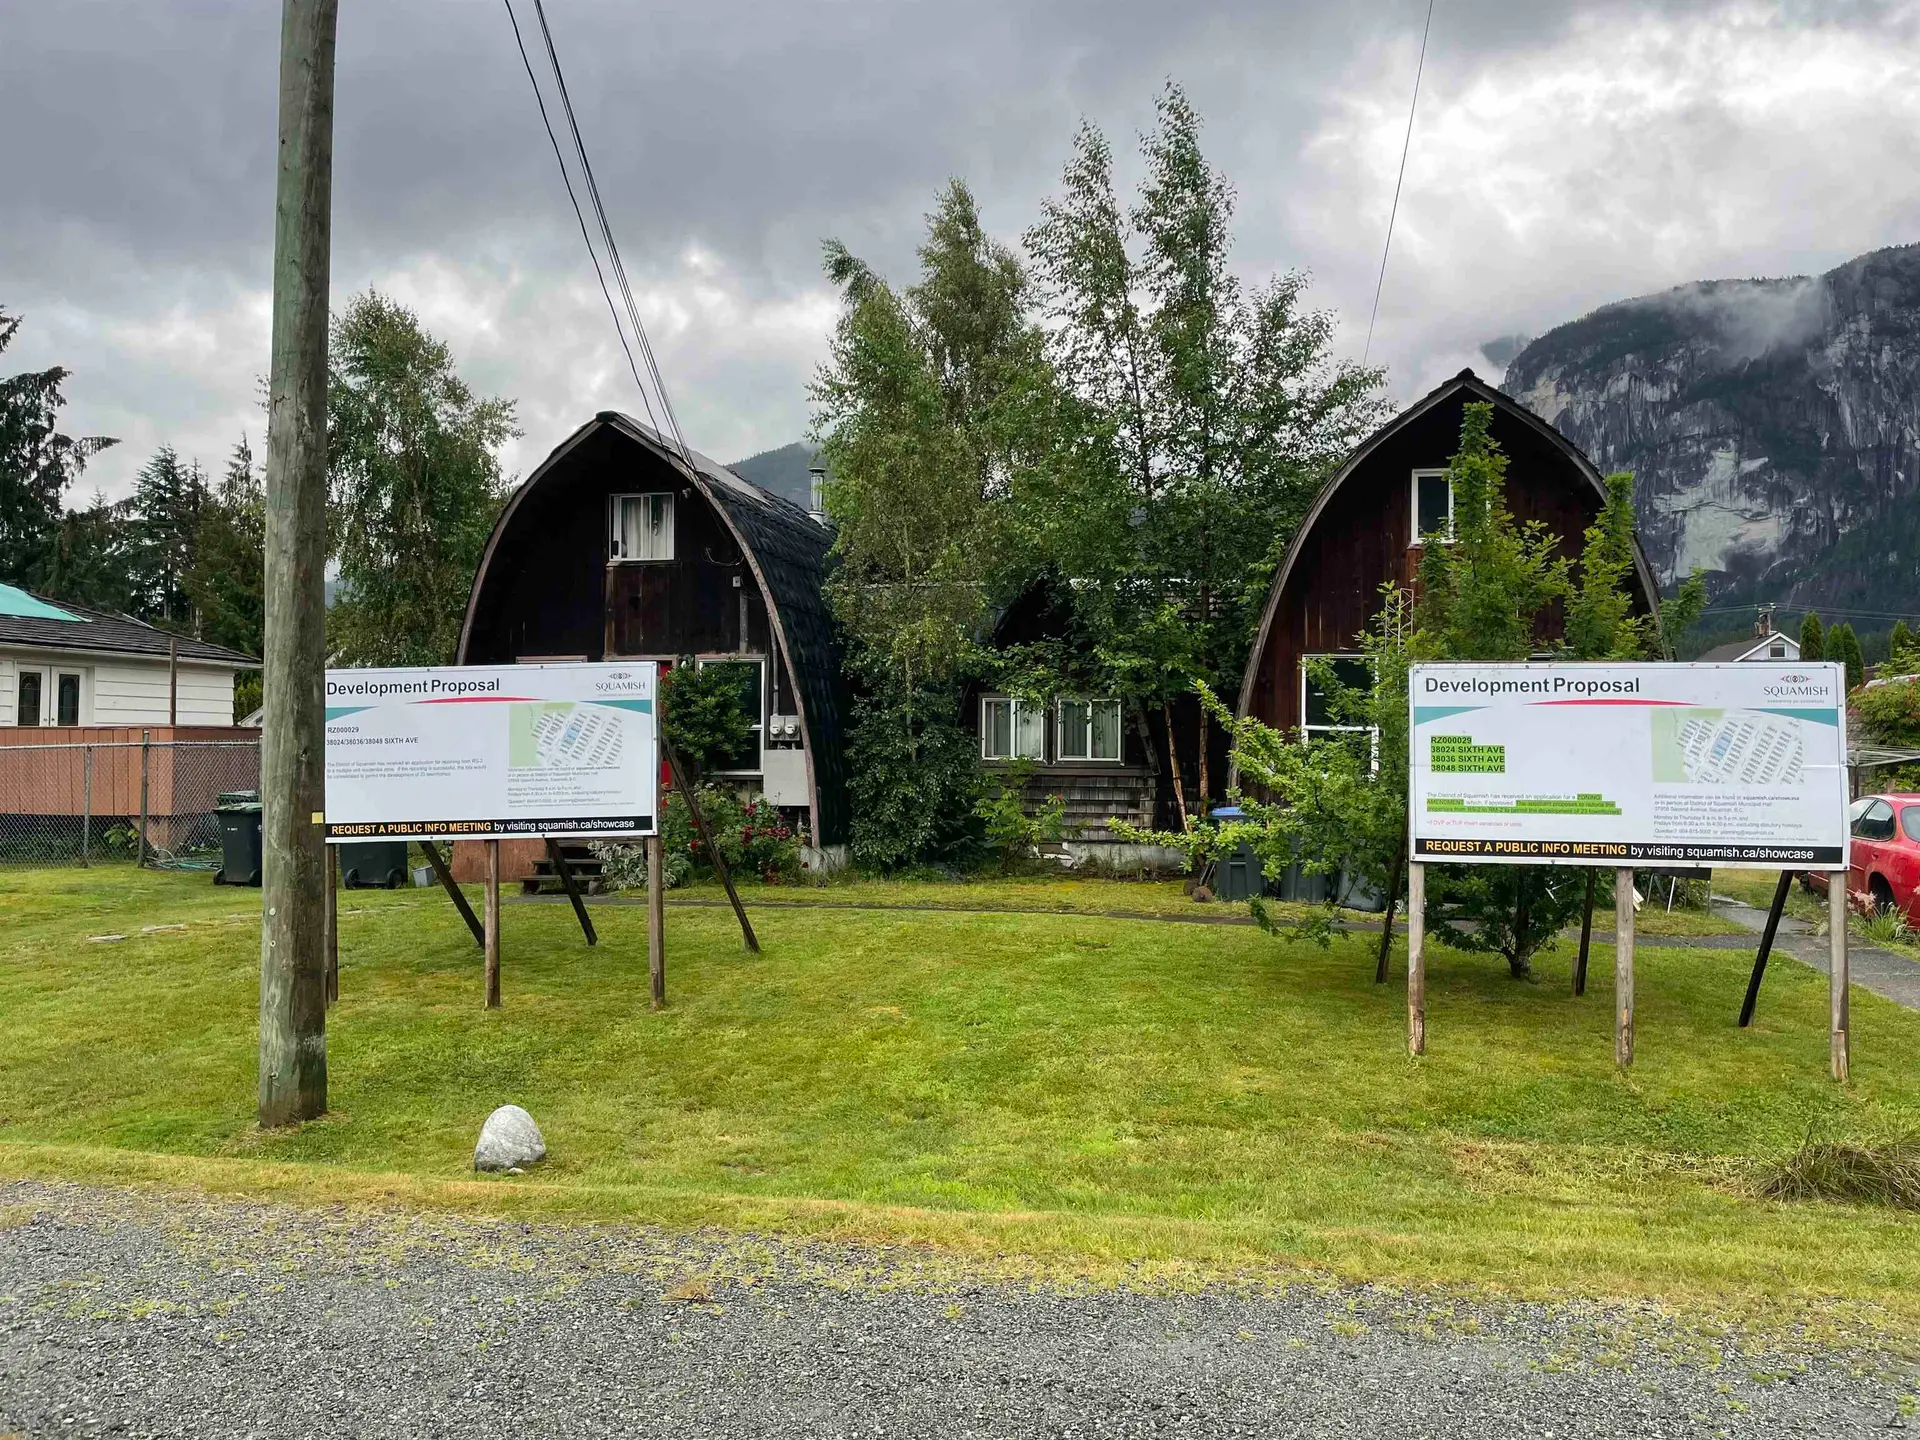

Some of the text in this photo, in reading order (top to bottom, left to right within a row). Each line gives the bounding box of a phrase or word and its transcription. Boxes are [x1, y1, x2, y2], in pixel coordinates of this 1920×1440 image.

[327, 678, 500, 696] Development Proposal
[595, 682, 646, 691] SQUAMISH
[1425, 678, 1640, 696] Development Proposal
[1763, 685, 1829, 698] SQUAMISH
[331, 820, 635, 835] REQUEST A PUBLIC INFO MEETING by visiting squamish.ca/showcase
[1426, 840, 1814, 860] REQUEST A PUBLIC INFO MEETING by visiting squamish.ca/showcase
